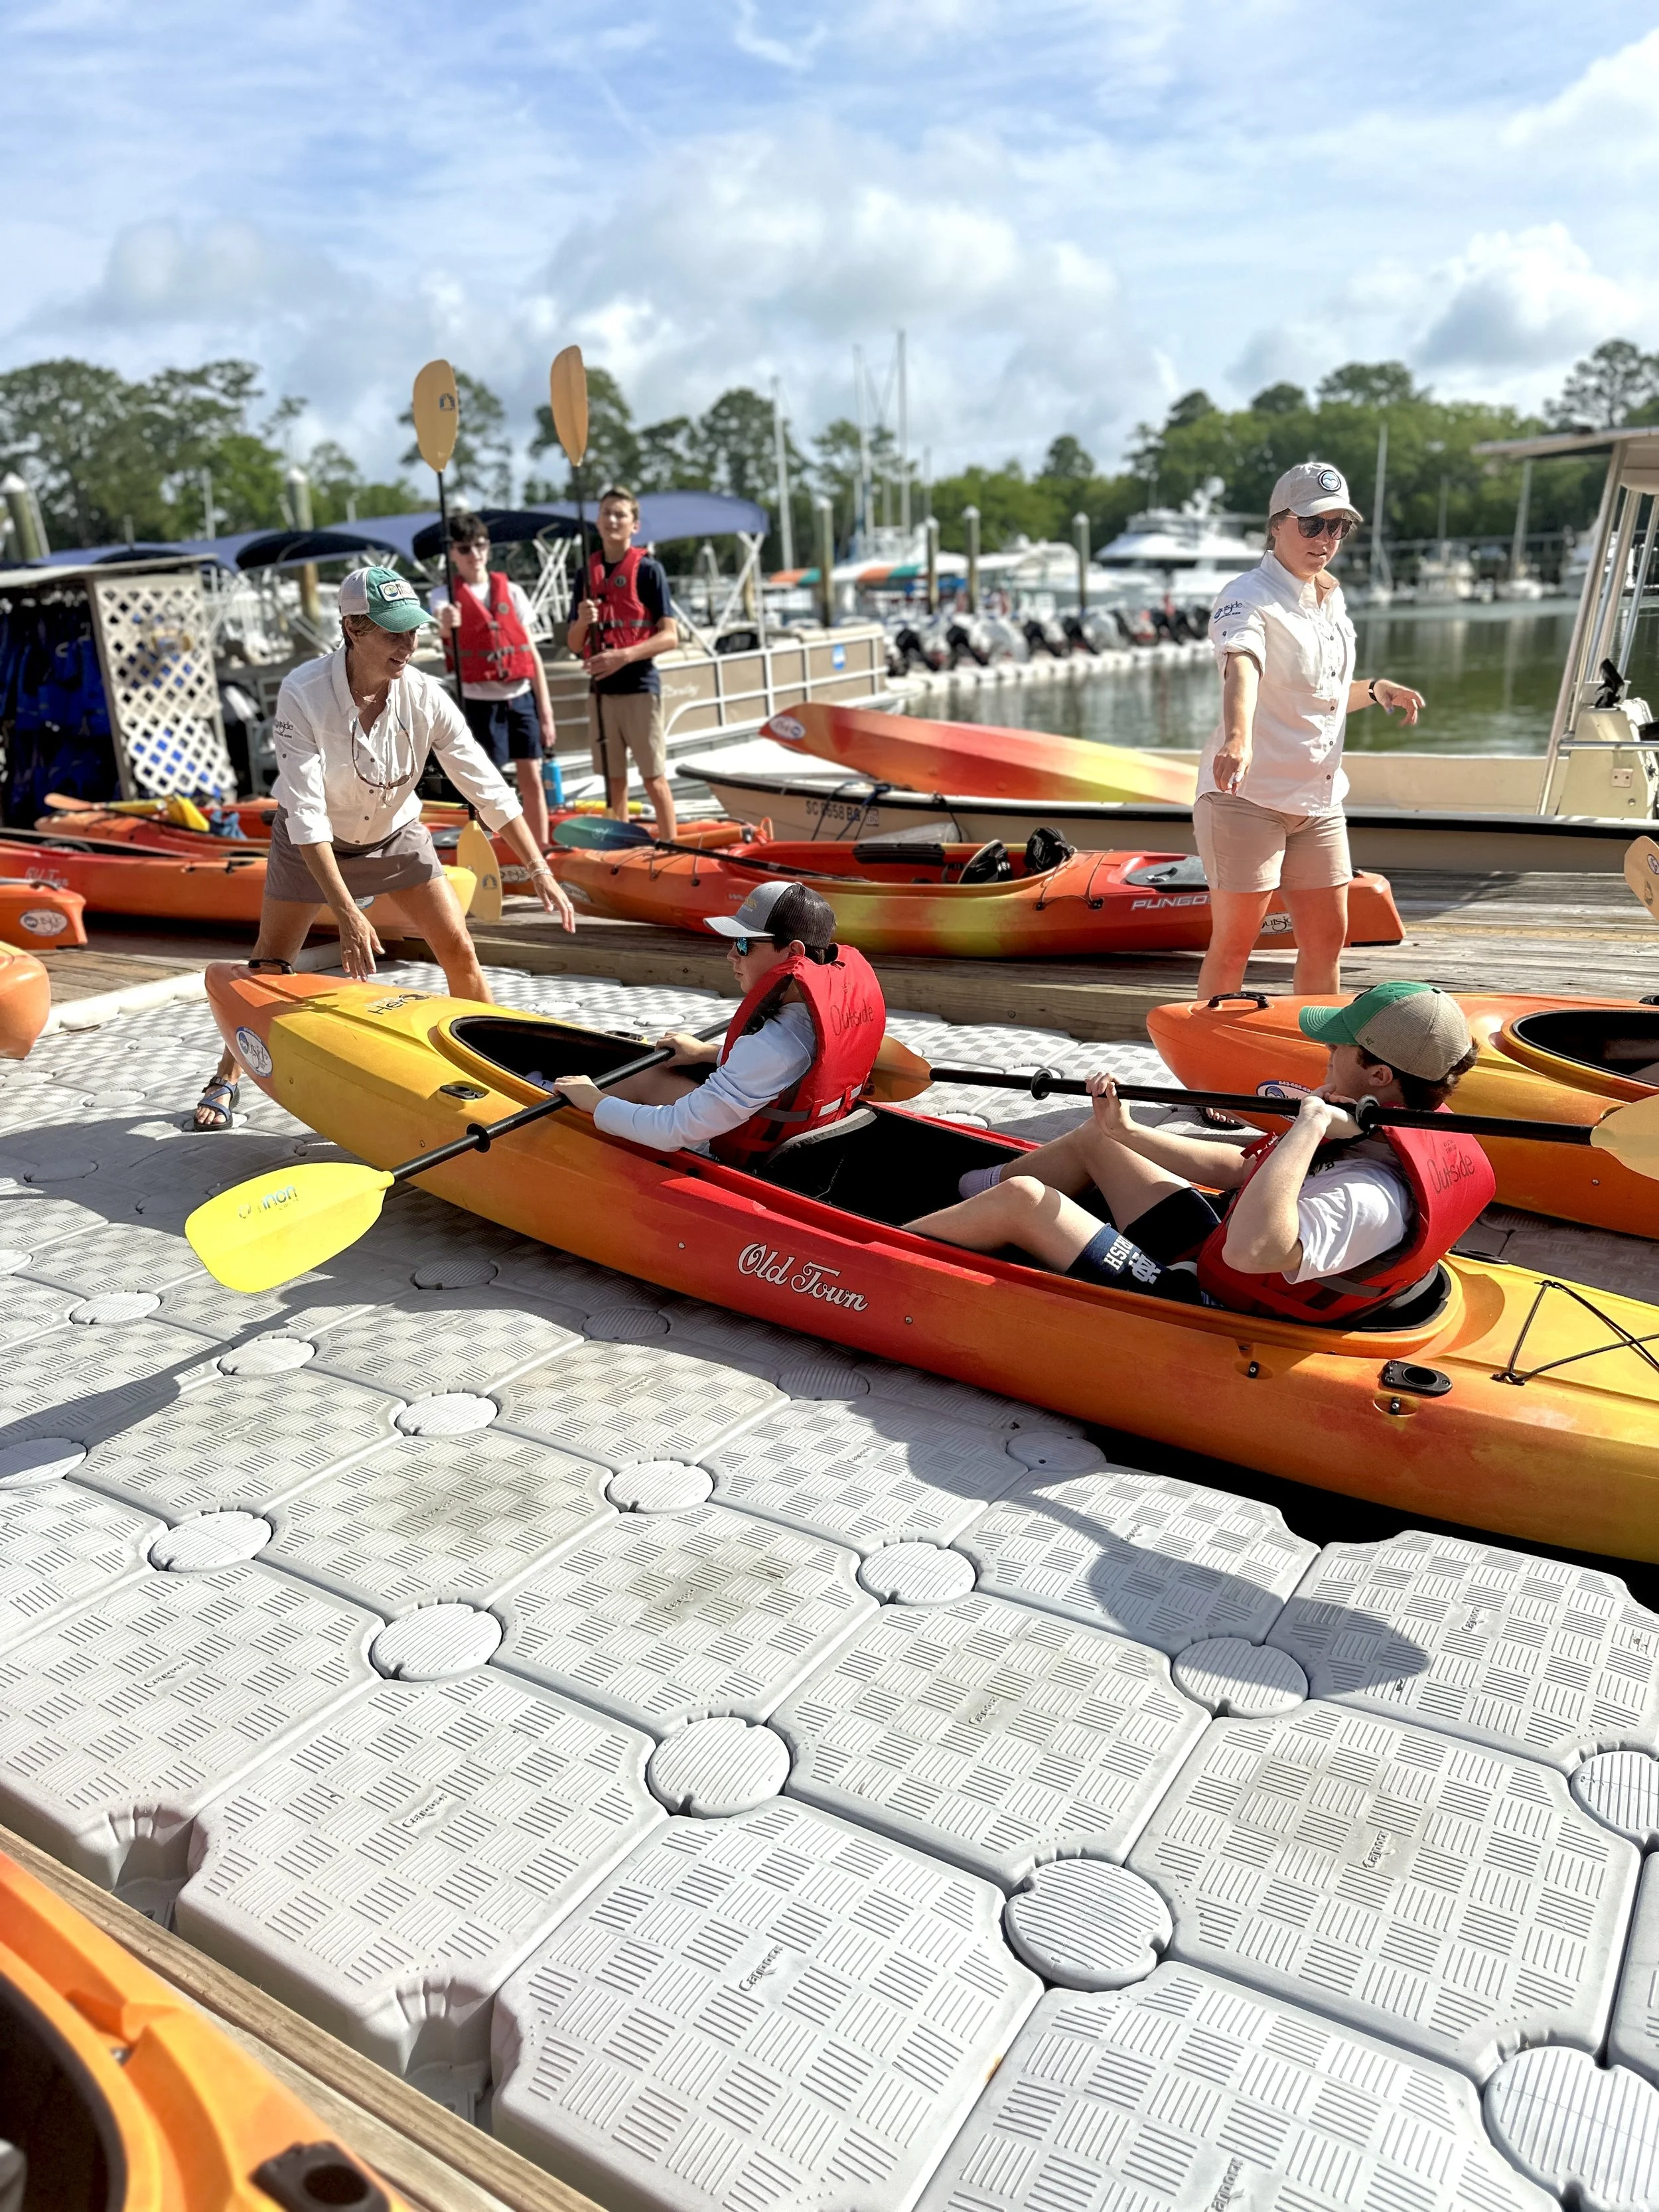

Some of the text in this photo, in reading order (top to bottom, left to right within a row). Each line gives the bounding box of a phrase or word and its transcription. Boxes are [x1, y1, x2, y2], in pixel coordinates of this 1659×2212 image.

[806, 800, 818, 815] SC
[1131, 895, 1208, 911] PUNGO
[830, 998, 874, 1036] Outside
[1427, 1151, 1476, 1195] Outside
[737, 1242, 869, 1312] Old Town
